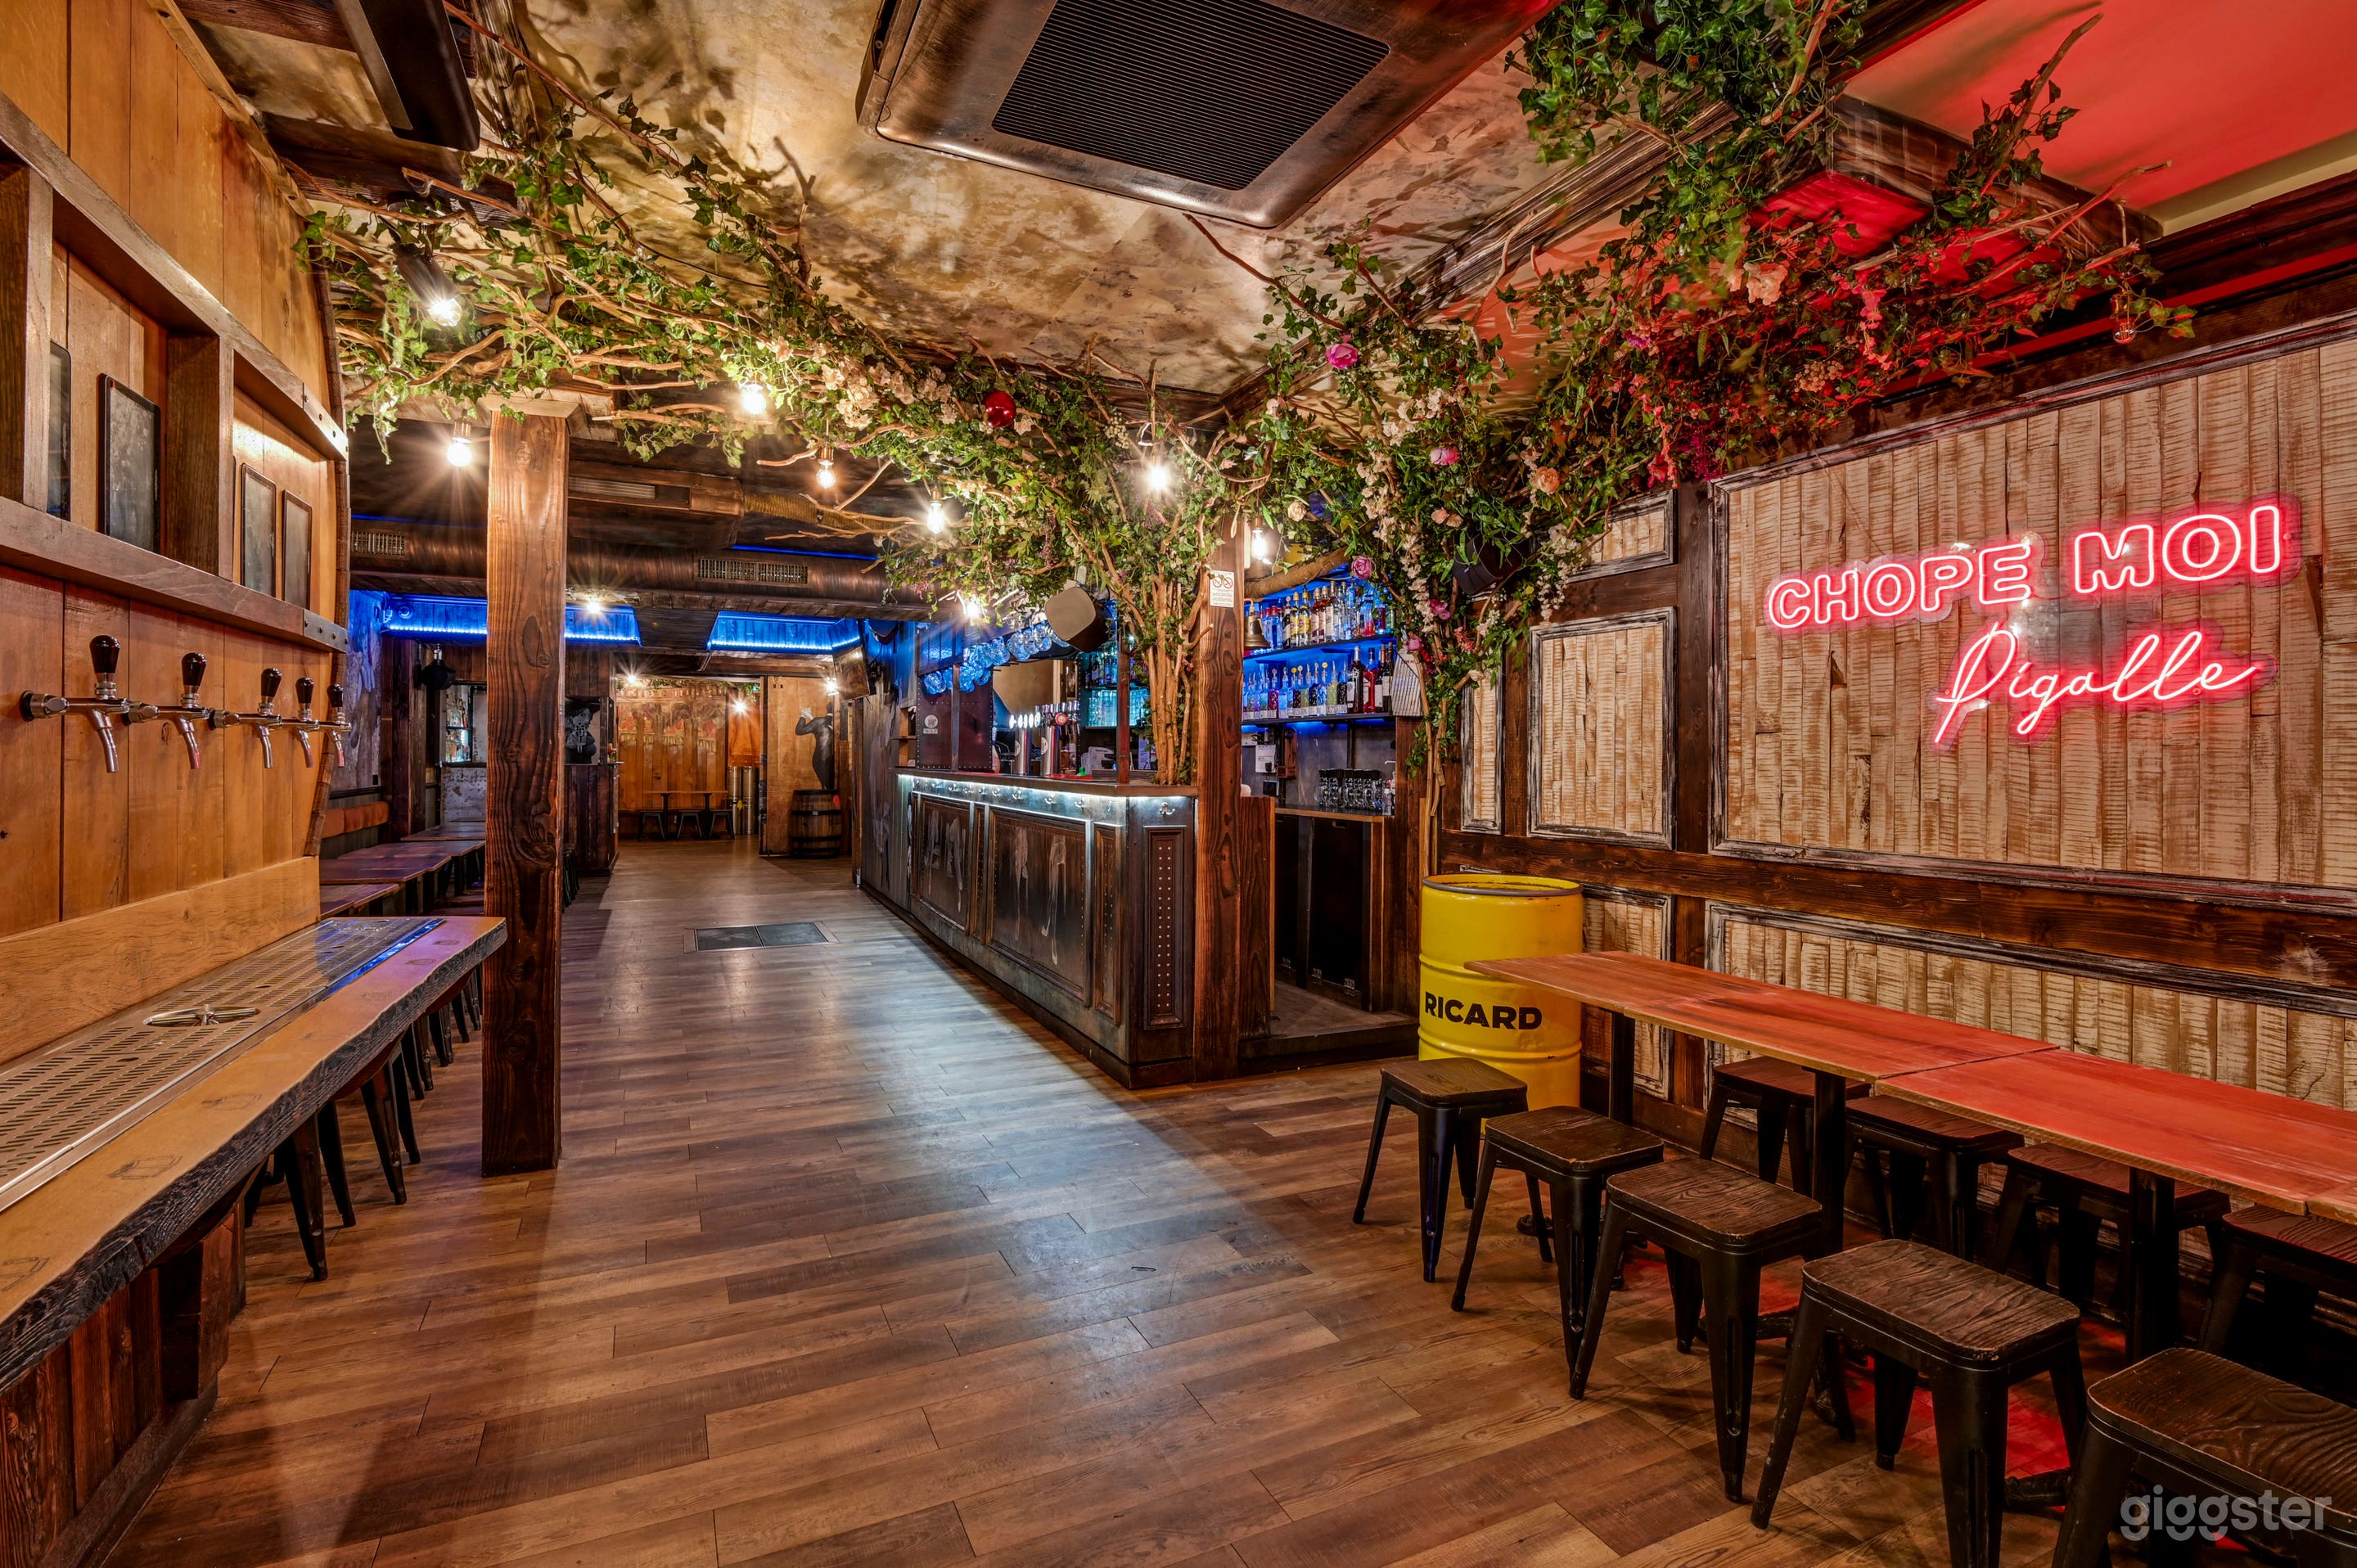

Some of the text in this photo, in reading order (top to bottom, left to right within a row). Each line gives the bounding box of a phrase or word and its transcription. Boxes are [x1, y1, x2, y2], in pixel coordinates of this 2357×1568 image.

[1768, 504, 2282, 629] CHOPE MOI
[1935, 621, 2259, 743] Pigalle
[1425, 991, 1543, 1030] RICARD
